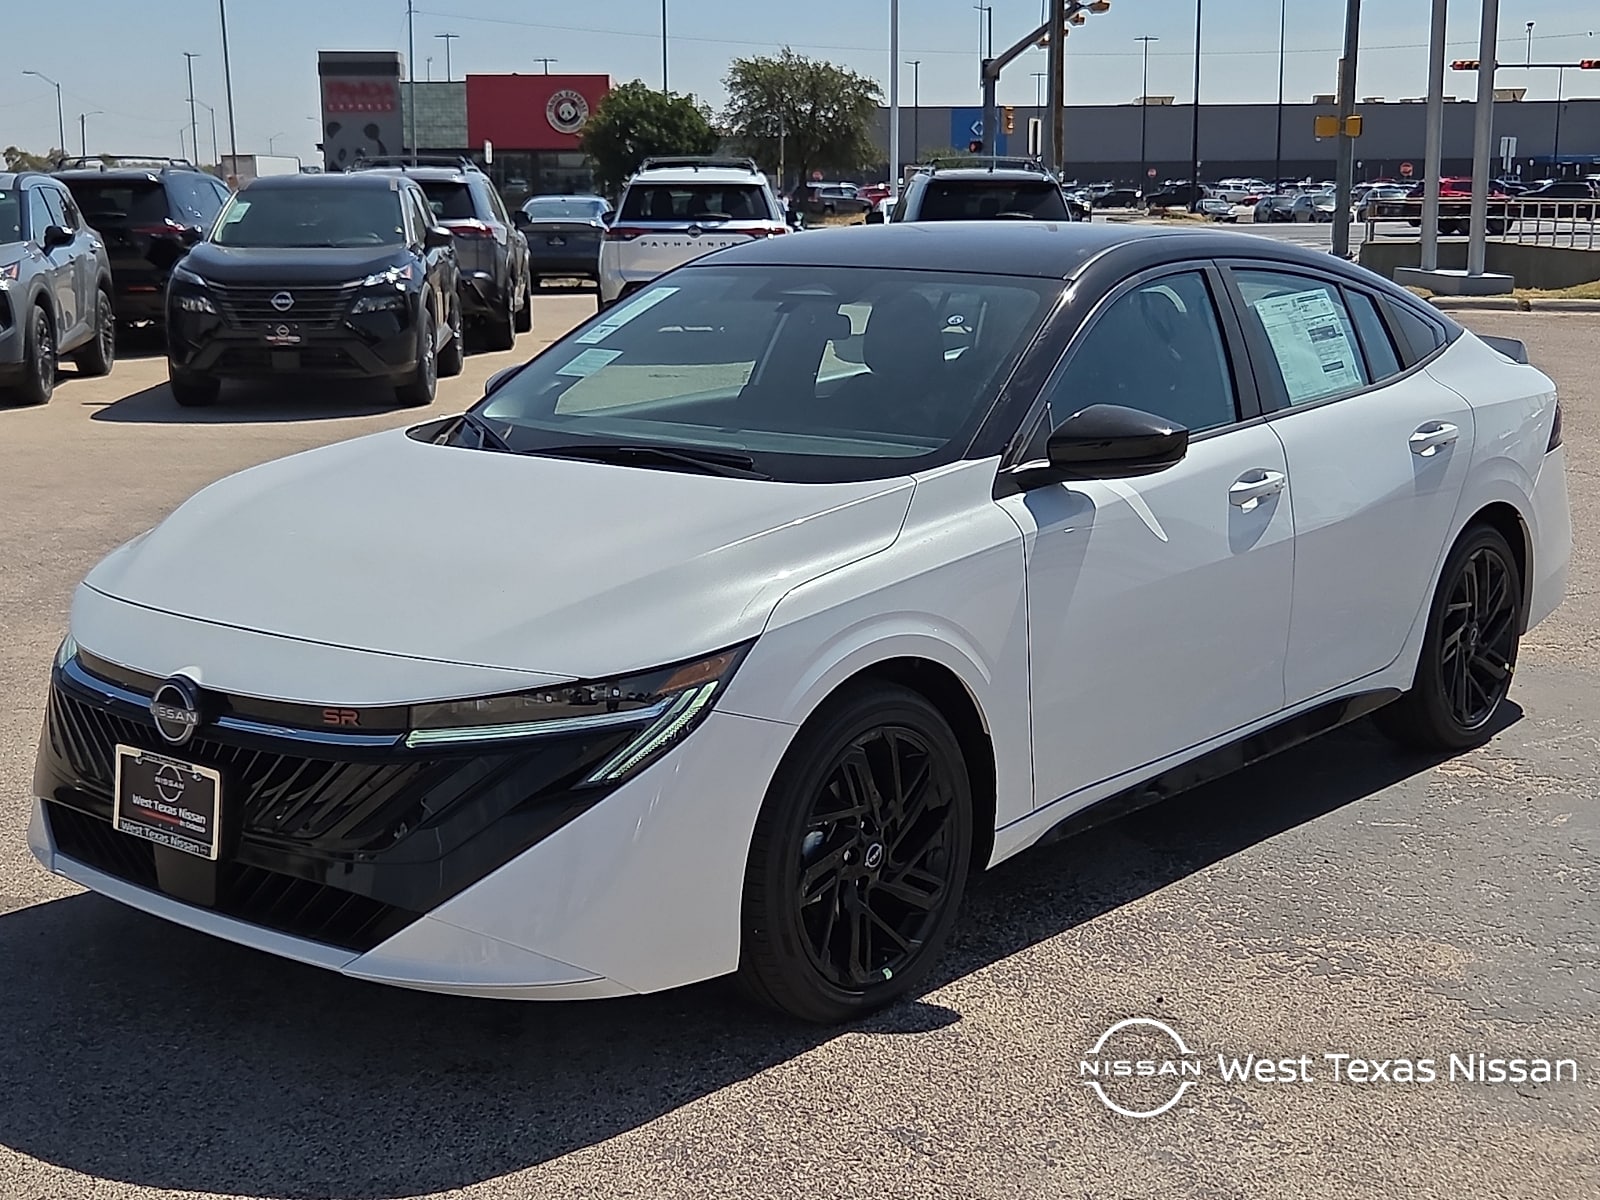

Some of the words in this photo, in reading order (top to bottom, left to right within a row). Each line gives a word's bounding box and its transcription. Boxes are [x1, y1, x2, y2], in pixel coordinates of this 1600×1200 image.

[150, 702, 198, 724] ISSAN
[322, 709, 360, 728] SR
[154, 775, 185, 790] NISSAN
[132, 793, 153, 809] West
[153, 800, 178, 816] Texas
[178, 807, 206, 825] Nissan
[120, 820, 143, 835] West
[144, 827, 170, 843] Texas
[170, 836, 200, 853] Nissan
